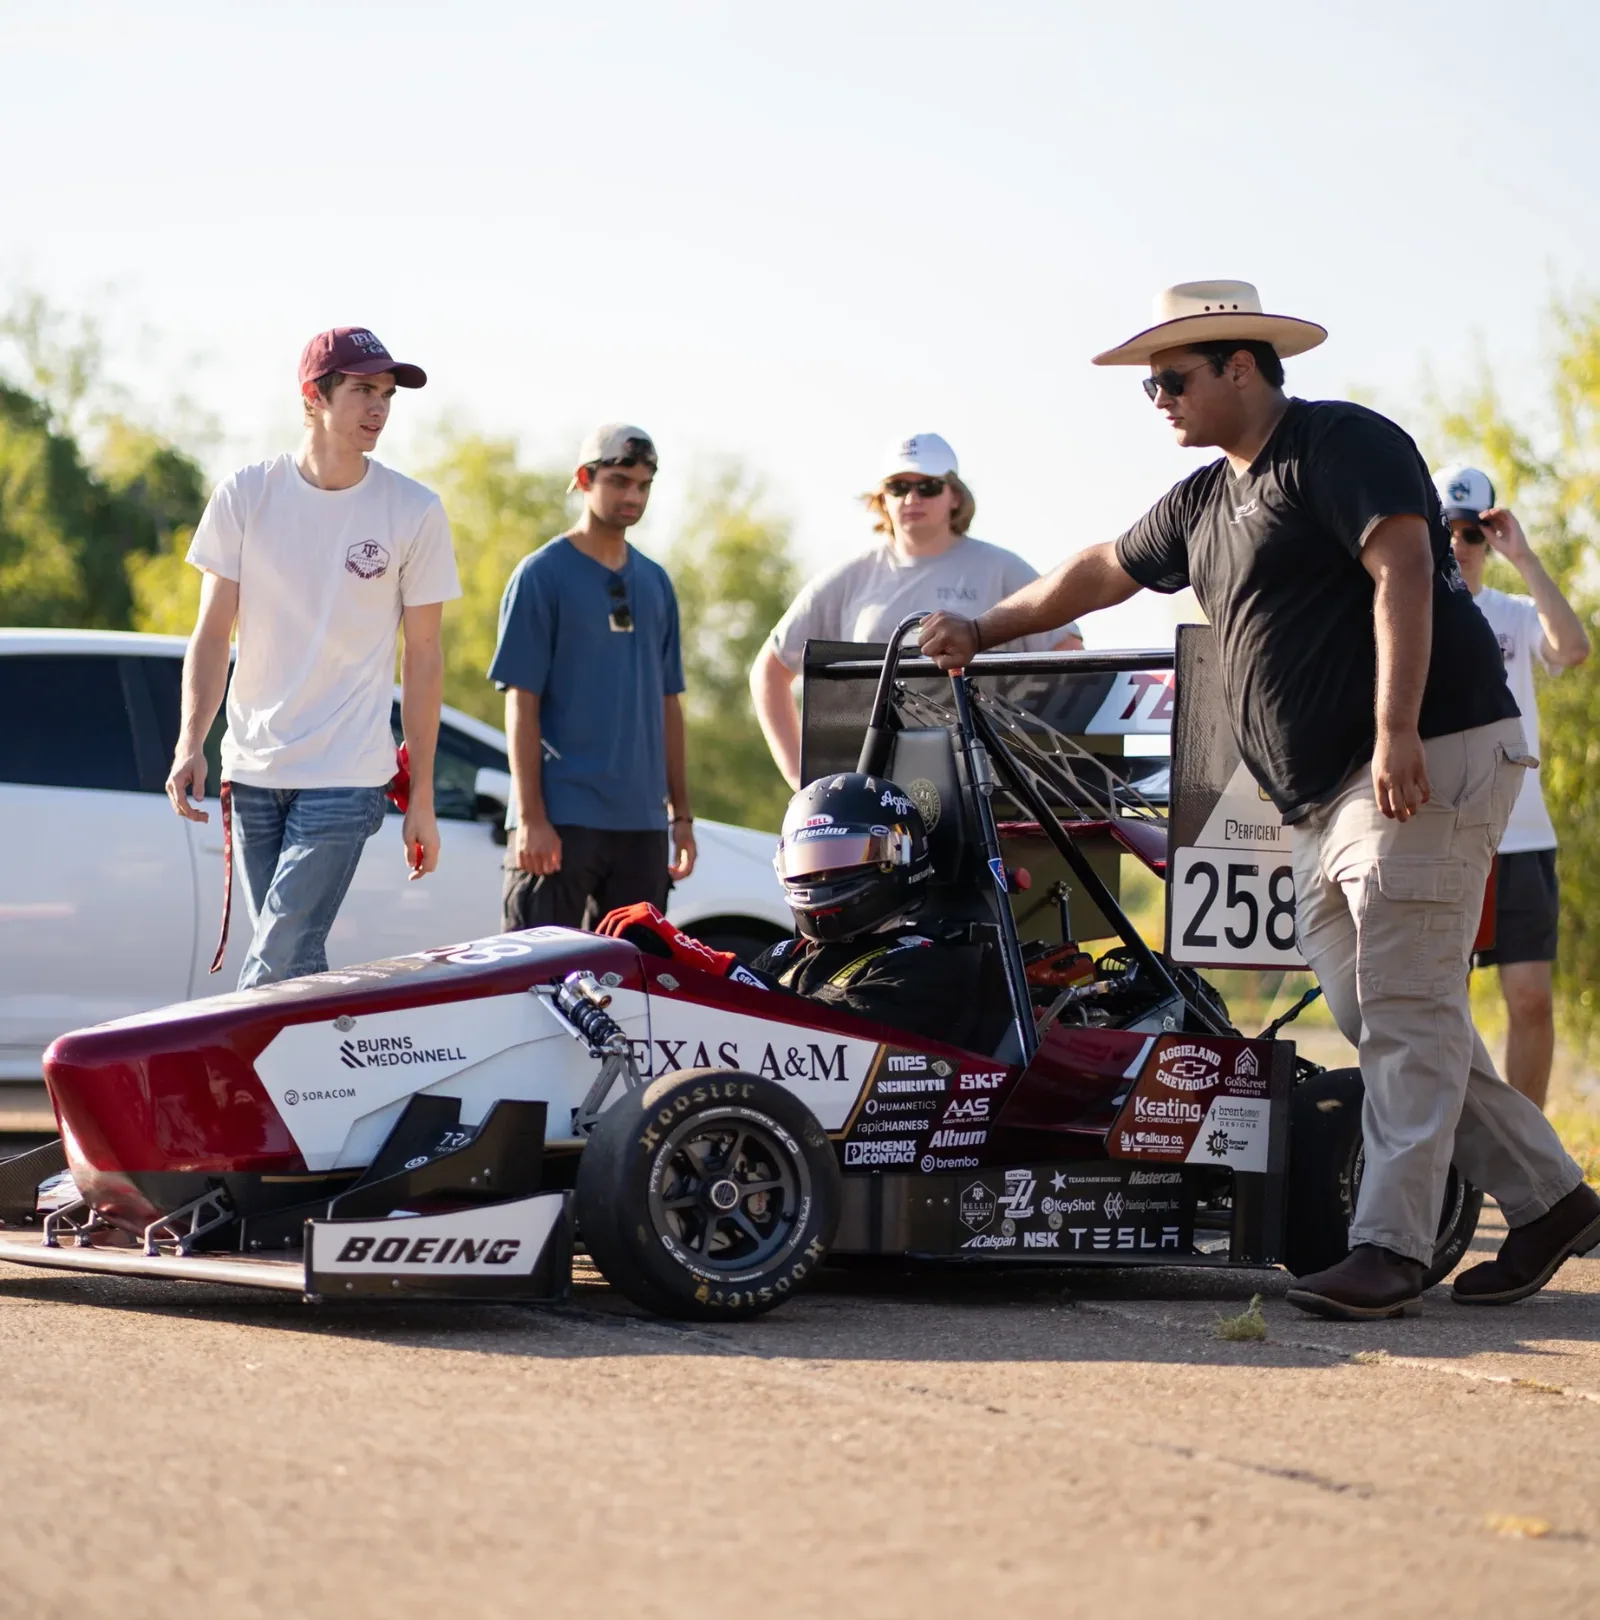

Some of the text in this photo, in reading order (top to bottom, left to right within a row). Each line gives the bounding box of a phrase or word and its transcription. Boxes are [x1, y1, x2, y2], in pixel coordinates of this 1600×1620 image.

[807, 817, 829, 827] BELL
[797, 826, 850, 840] Racing
[1225, 819, 1282, 842] PERFICIENT
[1182, 861, 1297, 951] 258
[357, 1036, 413, 1053] BURNS
[627, 1039, 850, 1081] EXAS A&M
[888, 1056, 927, 1072] MPS
[1159, 1045, 1222, 1067] AGGIELAND
[960, 1073, 1007, 1090] SKF
[1155, 1069, 1220, 1091] CHEVROLET
[302, 1088, 356, 1101] SORACOM
[879, 1100, 937, 1112] HUMANETICS
[638, 1081, 755, 1154] Hoosier
[857, 1120, 929, 1135] rapidHARNESS
[929, 1129, 987, 1148] Altium
[1215, 1138, 1229, 1150] US
[863, 1151, 916, 1164] CONTACT
[936, 1156, 979, 1169] brembo
[963, 1202, 993, 1210] RELLIS
[1055, 1199, 1096, 1214] KeyShot
[976, 1234, 1017, 1249] Calspan
[1023, 1231, 1059, 1247] NSK
[1068, 1227, 1179, 1249] TESLA
[335, 1236, 521, 1265] BOEING
[687, 1263, 721, 1281] RACING
[708, 1234, 825, 1308] Hoosier
